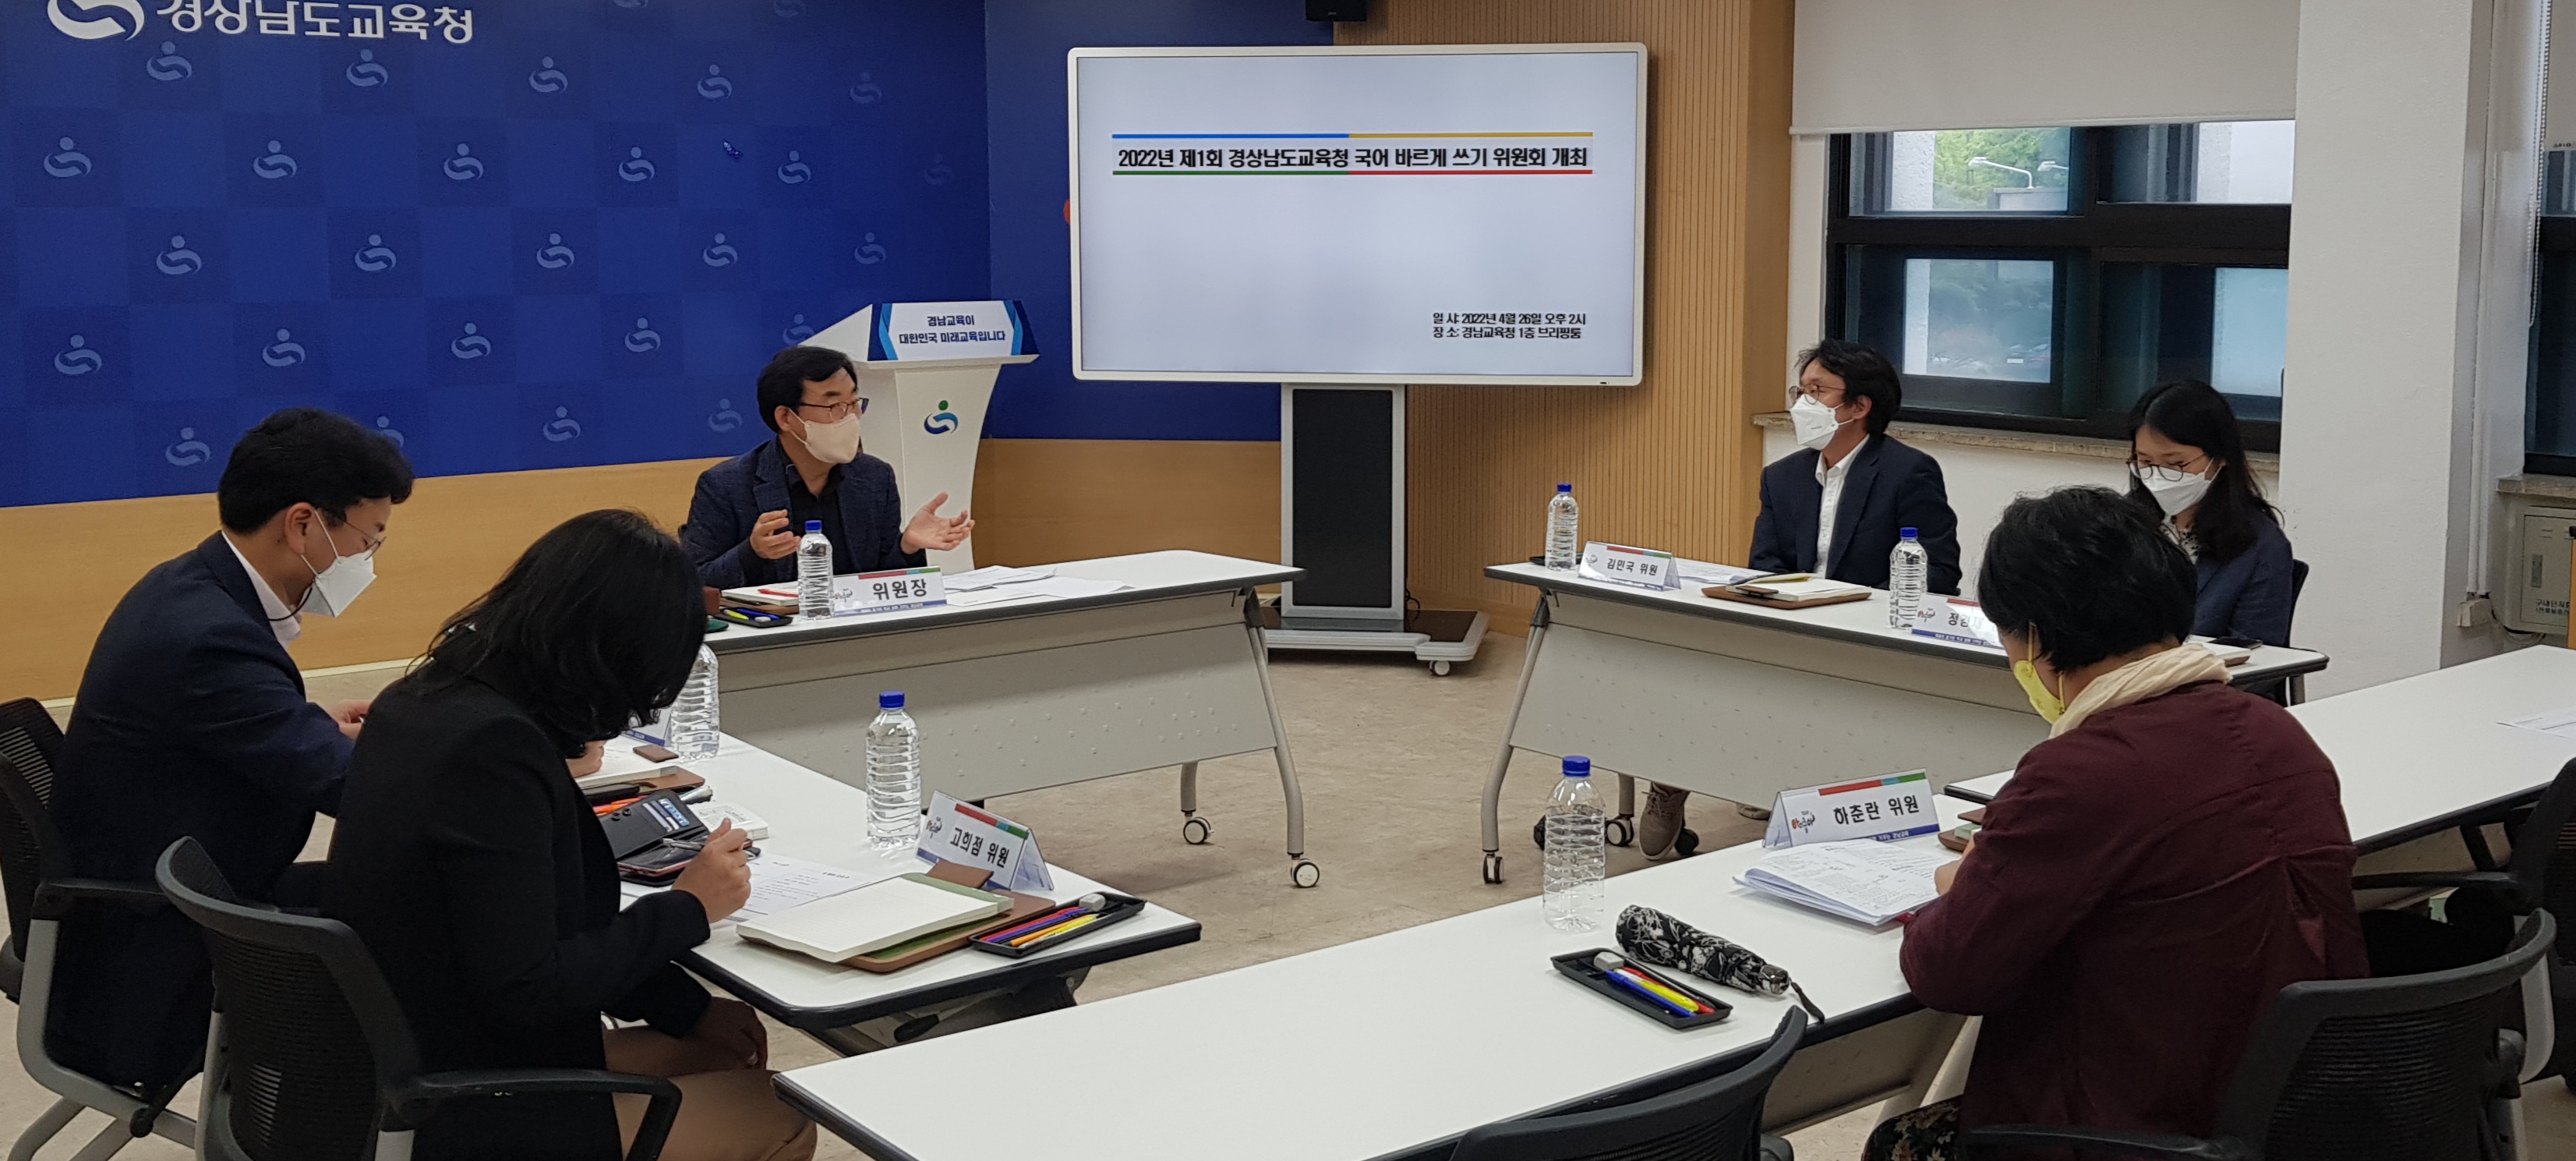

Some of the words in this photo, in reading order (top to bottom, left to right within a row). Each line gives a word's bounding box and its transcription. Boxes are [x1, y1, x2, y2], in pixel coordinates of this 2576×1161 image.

[157, 0, 474, 44] 경상남도교육청
[1118, 149, 1174, 168] 2022년
[1179, 149, 1222, 168] 제1회
[1228, 149, 1349, 168] 경상남도교육청
[1355, 148, 1389, 168] 국어
[1395, 148, 1447, 168] 바르게
[1452, 148, 1487, 167] 쓰기
[1493, 147, 1546, 167] 위원회
[1552, 147, 1587, 167] 개최
[927, 315, 975, 327] 경남교육이
[1433, 313, 1443, 324] 일
[1461, 313, 1496, 324] 2022년
[1499, 313, 1516, 324] 4월
[1518, 313, 1542, 324] 26일
[1544, 313, 1567, 324] 오후
[1568, 313, 1585, 324] 2시
[899, 332, 938, 344] 대한민국
[940, 331, 1005, 343] 미래교육입니다
[1433, 327, 1443, 338] 장
[1461, 327, 1515, 338] 경남교육청
[1518, 327, 1535, 338] 1층
[1538, 327, 1581, 339] 브리핑룸
[1607, 558, 1634, 573] 김민국
[1639, 563, 1659, 576] 위원
[872, 579, 928, 600] 위원장
[1832, 801, 1881, 826] 하춘란
[1888, 795, 1920, 816] 위원
[949, 827, 984, 857] 고희점
[987, 843, 1010, 869] 위원
